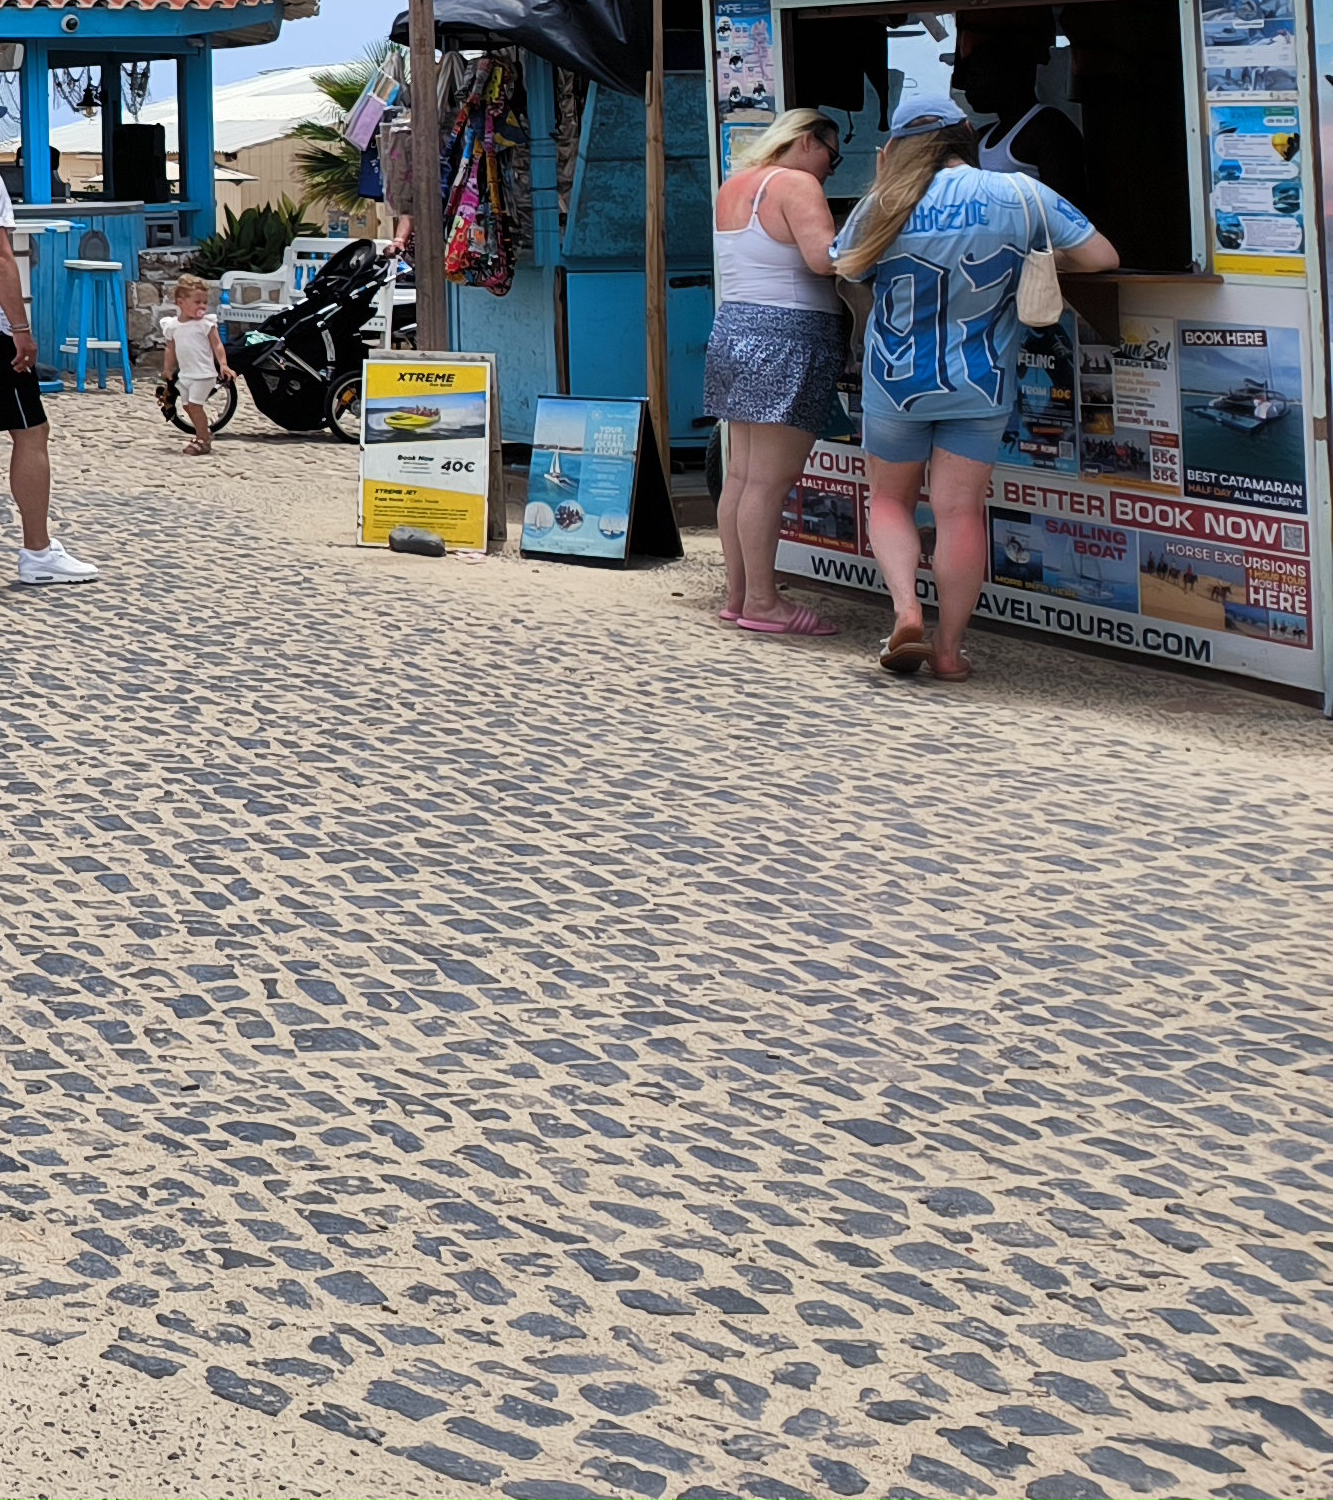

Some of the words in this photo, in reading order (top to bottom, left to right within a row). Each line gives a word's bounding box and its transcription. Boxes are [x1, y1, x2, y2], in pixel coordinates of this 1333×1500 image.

[1185, 331, 1224, 345] BOOK
[1227, 331, 1264, 345] HERE
[1114, 359, 1142, 368] BEACH
[397, 372, 456, 383] XTREME
[1021, 385, 1047, 397] FROM
[594, 432, 628, 441] PERFECT
[600, 426, 623, 434] YOUR
[595, 440, 624, 448] OCEAN
[441, 460, 475, 473] 40€
[808, 451, 866, 477] YOUR
[1152, 452, 1177, 466] 55€
[1152, 469, 1178, 483] 35€
[1187, 468, 1218, 484] BEST
[1219, 473, 1303, 496] CATAMARAN
[801, 477, 823, 490] SALT
[824, 481, 855, 495] LAKES
[1002, 481, 1106, 518] BETTER
[1187, 483, 1213, 495] HALF
[1213, 487, 1233, 498] DAY
[1233, 490, 1252, 501] ALL
[1253, 493, 1303, 509] INCLUSIVE
[1114, 497, 1195, 532] BOOK
[1204, 511, 1279, 545] NOW
[1044, 518, 1128, 546] SAILING
[1073, 540, 1128, 562] BOAT
[1165, 541, 1211, 561] HORSE
[1214, 551, 1307, 578] EXCURSIONS
[994, 574, 1023, 590] MORE
[1254, 570, 1280, 581] HOUR
[1282, 574, 1307, 586] TOUR
[1249, 578, 1279, 591] MORE
[1281, 583, 1307, 596] INFO
[1249, 587, 1308, 615] HERE
